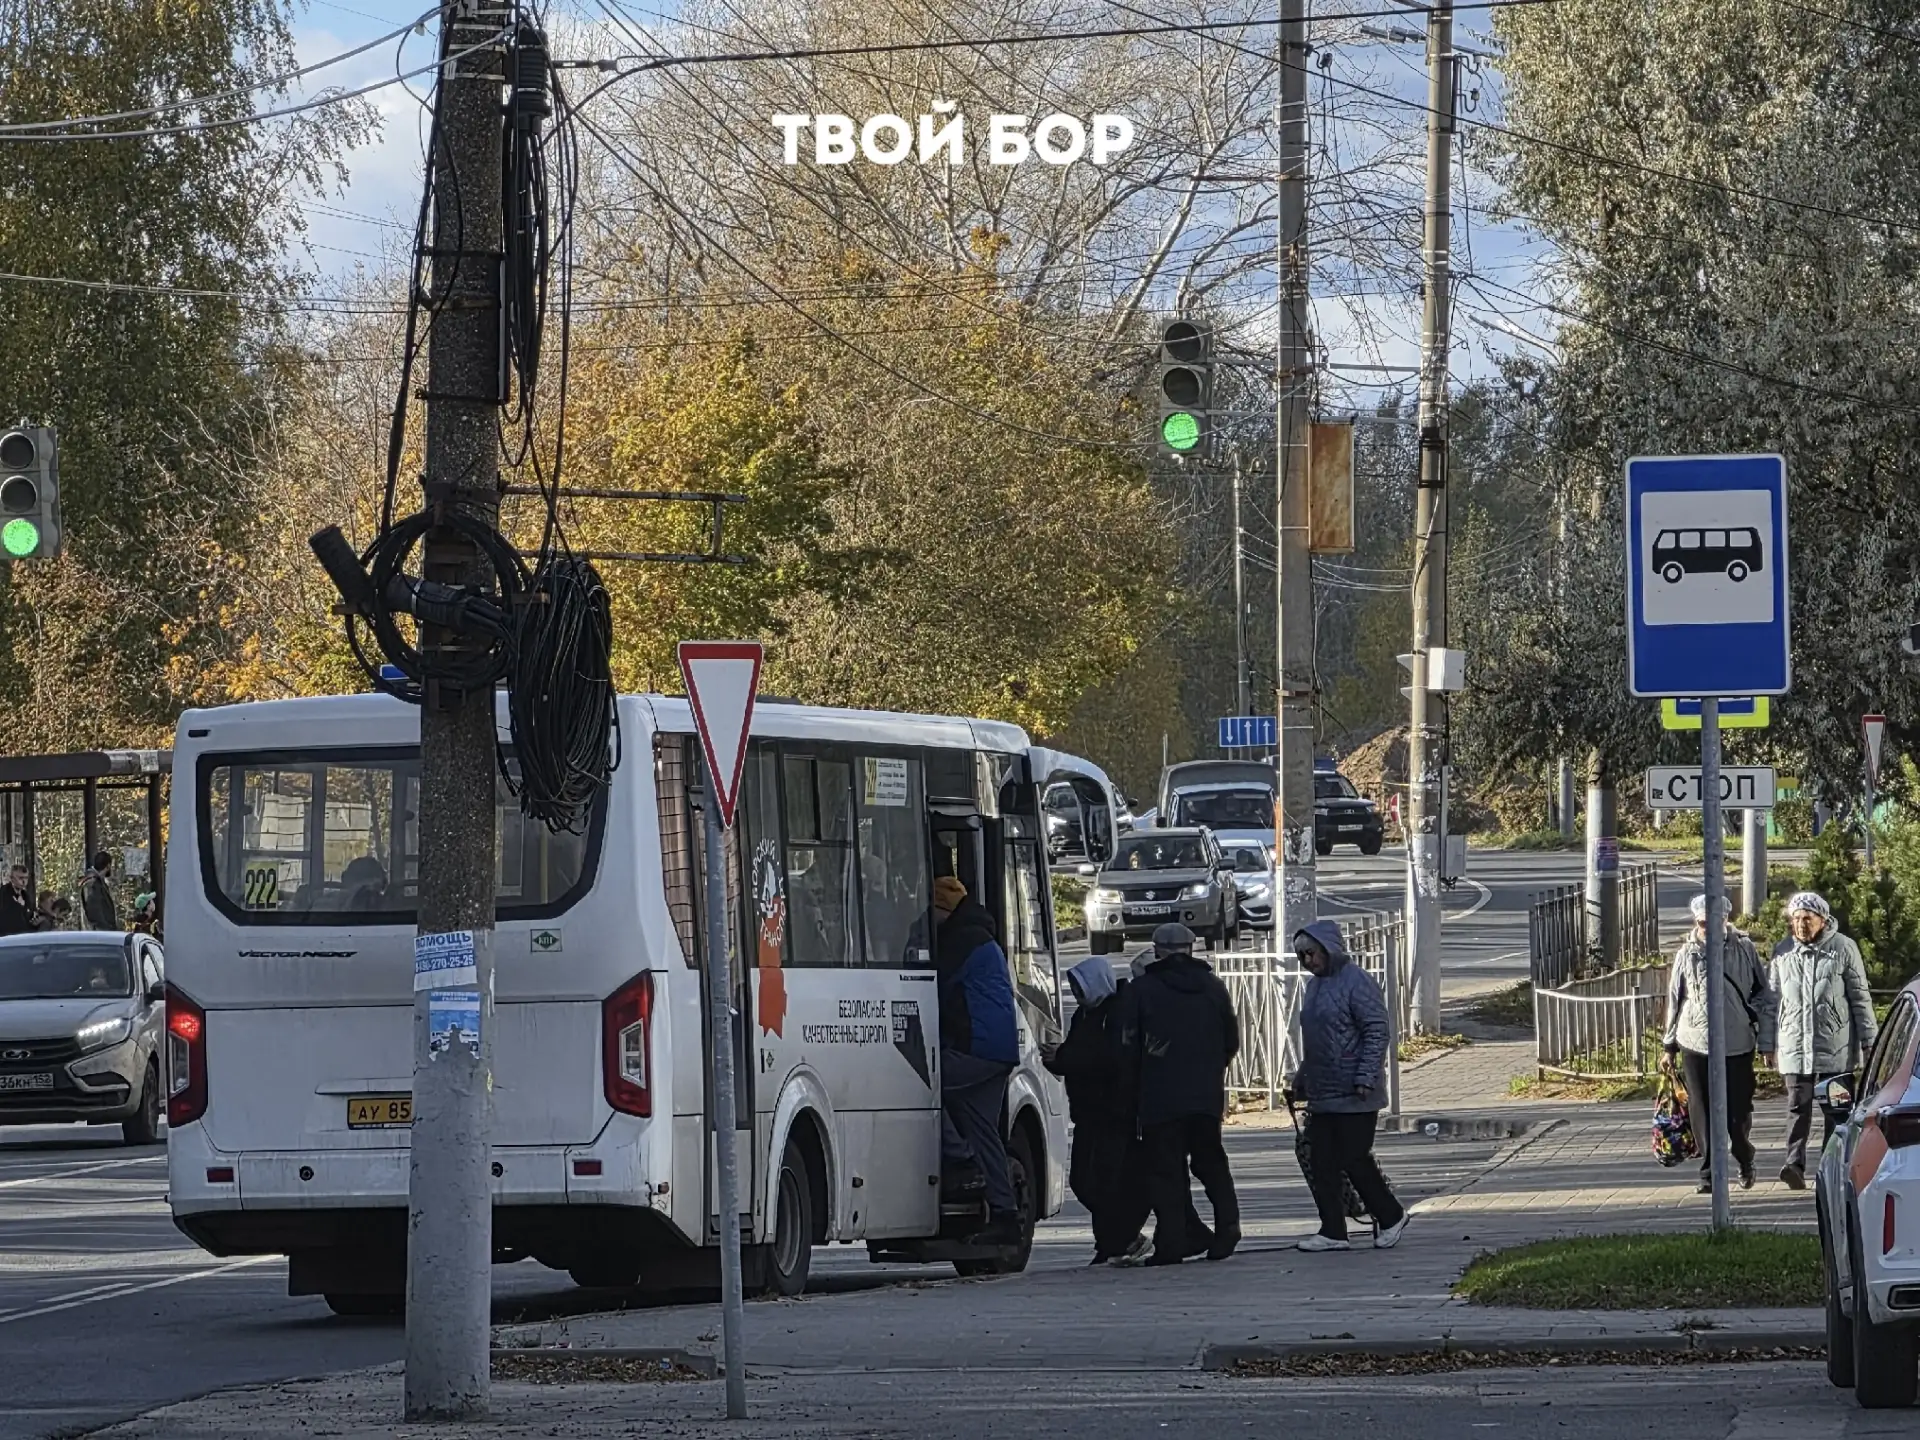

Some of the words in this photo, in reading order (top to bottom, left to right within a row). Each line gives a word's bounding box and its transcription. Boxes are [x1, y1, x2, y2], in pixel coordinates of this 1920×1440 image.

[244, 868, 277, 909] 222
[415, 932, 473, 949] ПОМОЩЬ
[238, 950, 301, 958] VECTOR
[838, 999, 887, 1019] БЕЗОПАСНЫЕ
[802, 1024, 860, 1044] КАЧЕСТВЕННЫЕ
[860, 1024, 888, 1048] ДОРОГИ
